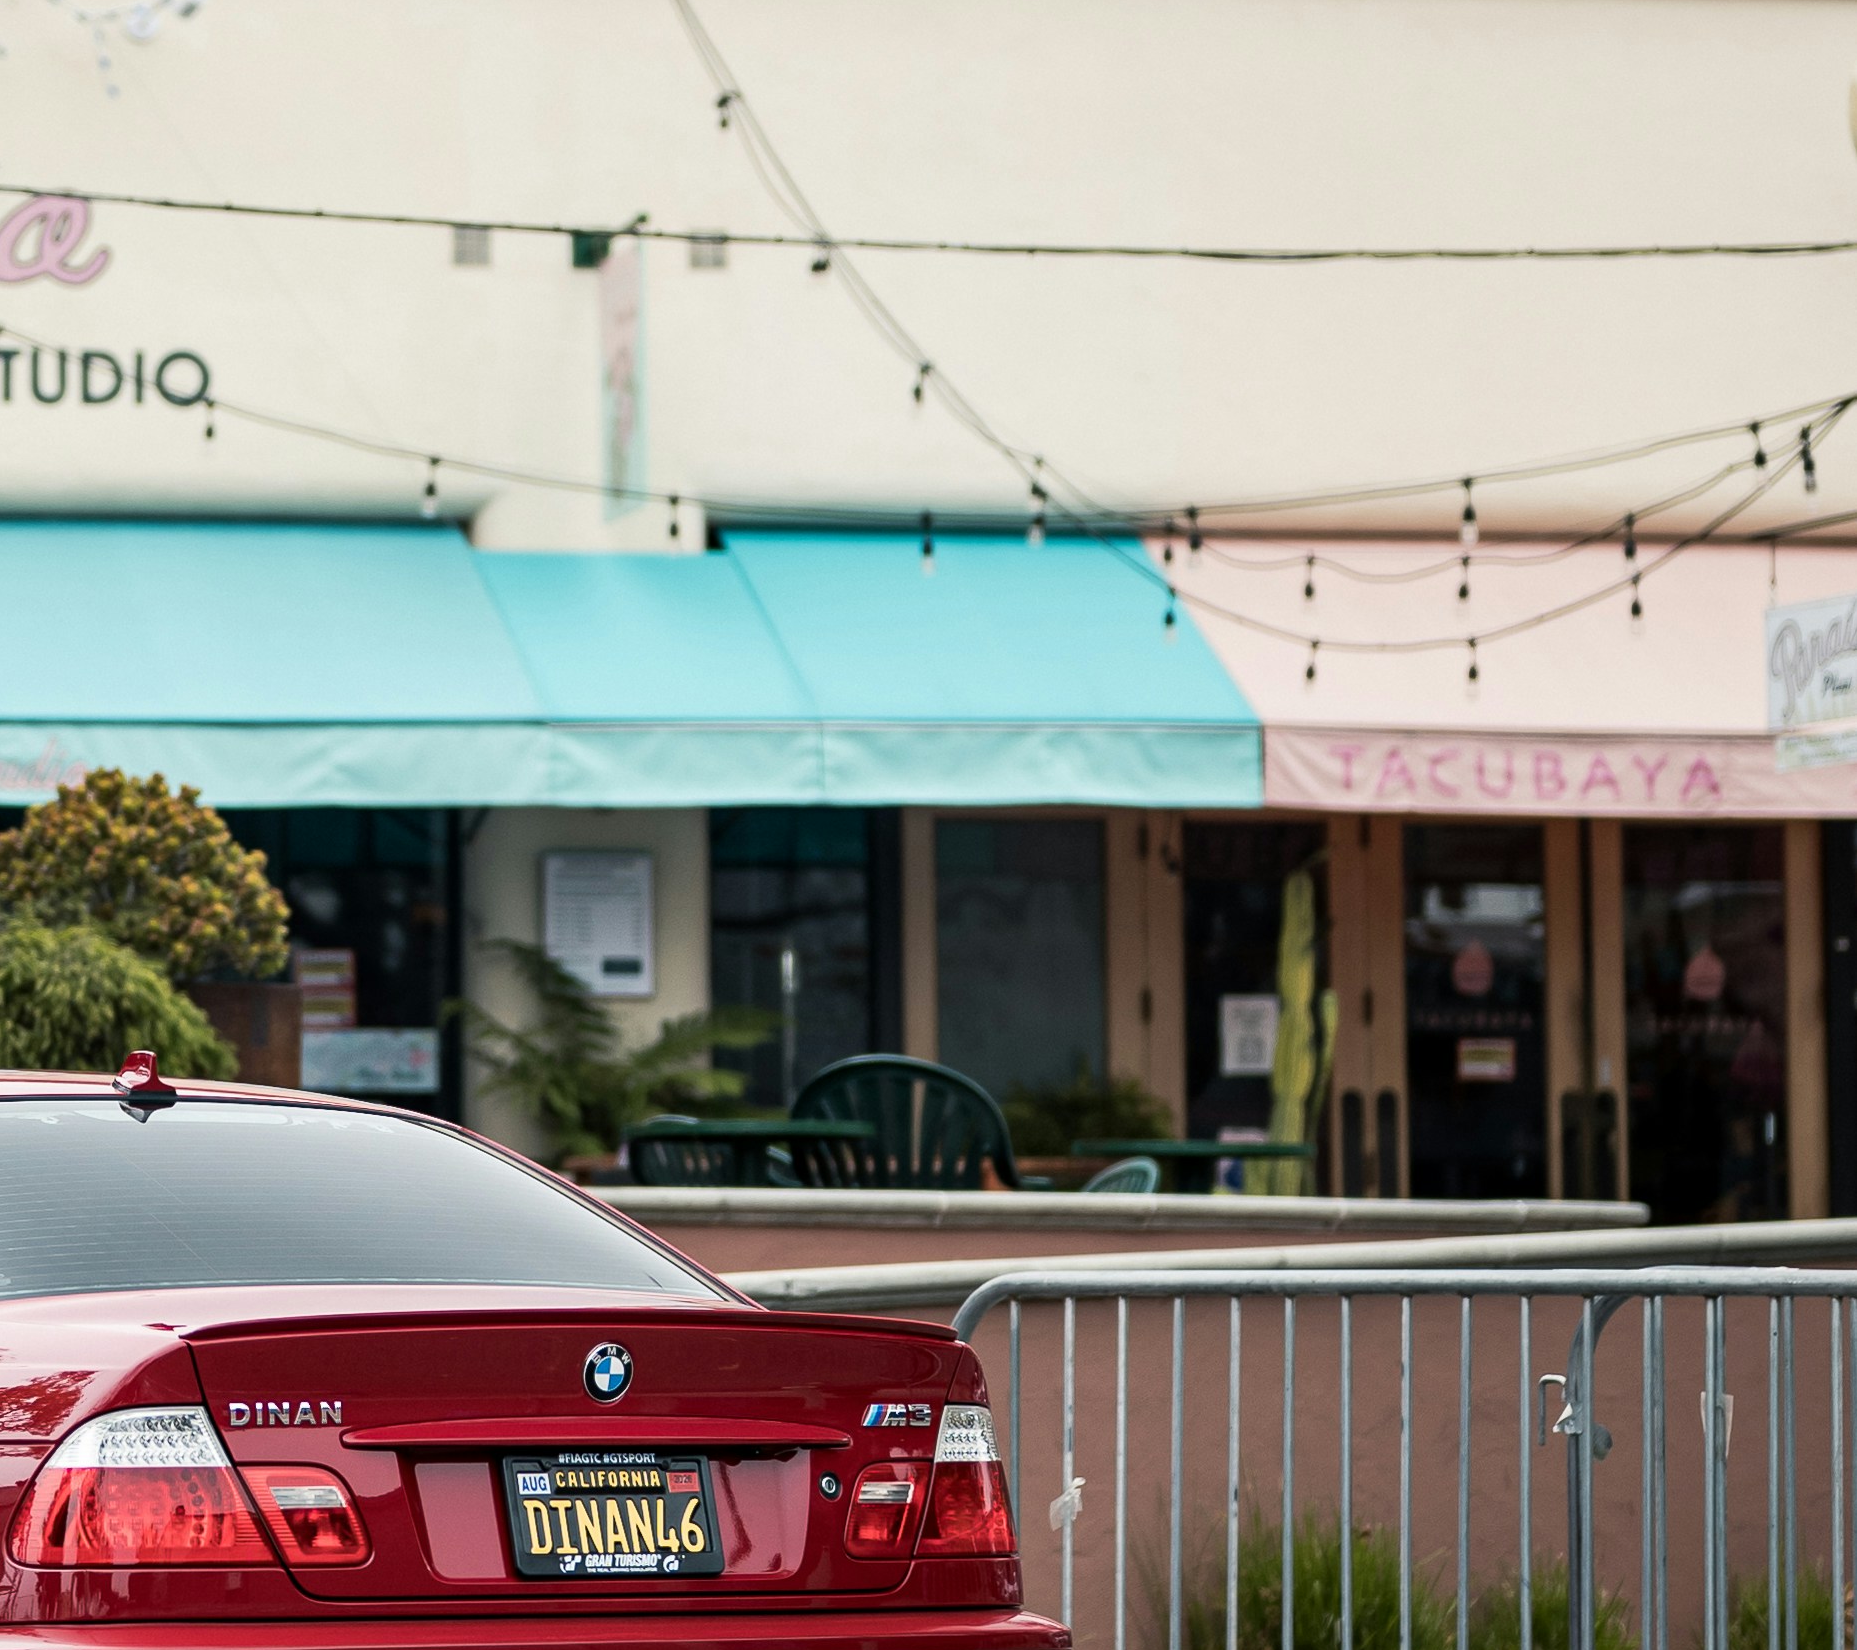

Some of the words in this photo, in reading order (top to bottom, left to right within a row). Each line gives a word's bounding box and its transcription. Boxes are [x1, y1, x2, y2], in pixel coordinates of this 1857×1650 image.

[1327, 743, 1725, 803] TACUBAYA
[228, 1401, 342, 1426] DINAN
[878, 1403, 932, 1427] M3
[558, 1453, 601, 1464] #FIAGTC
[603, 1453, 656, 1464] #GTSPORT
[522, 1475, 548, 1492] AUG
[555, 1470, 662, 1489] CALIFORNIA
[522, 1498, 706, 1555] DINAN46
[585, 1554, 613, 1568] GRAN
